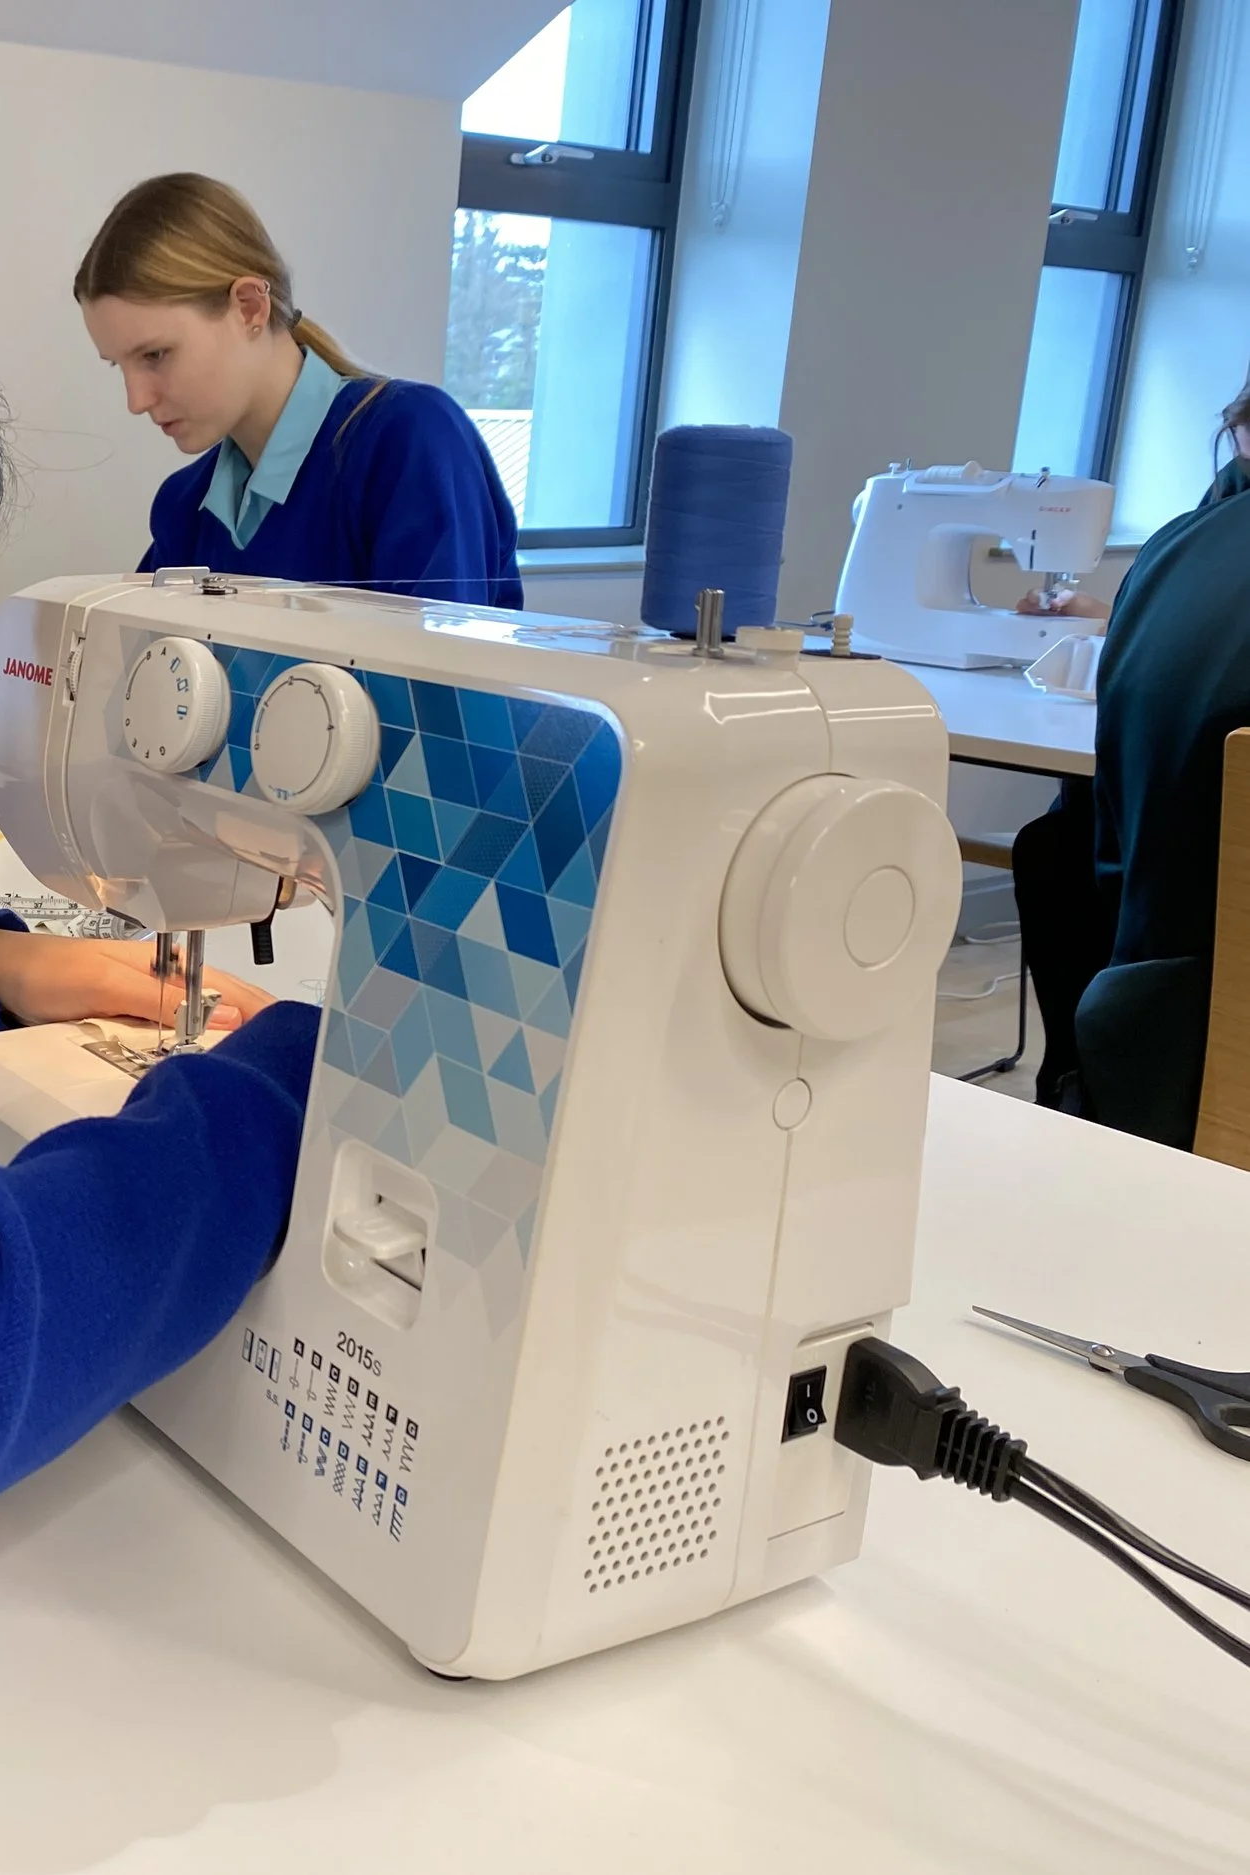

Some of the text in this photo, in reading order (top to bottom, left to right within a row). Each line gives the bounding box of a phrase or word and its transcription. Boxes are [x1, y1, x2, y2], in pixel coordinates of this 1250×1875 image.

[160, 646, 167, 656] A
[2, 657, 54, 687] JANOME
[68, 902, 79, 910] 38
